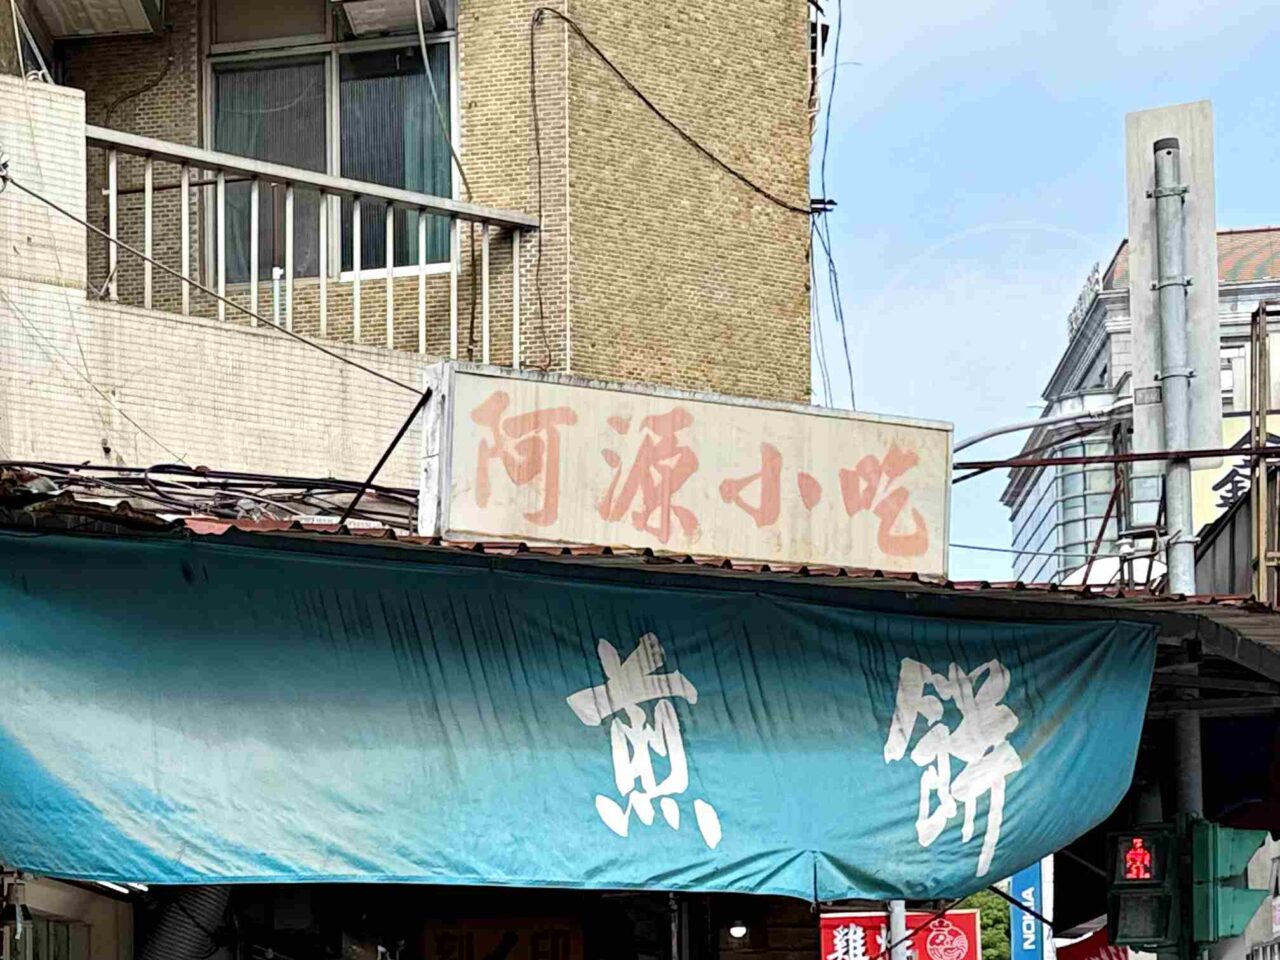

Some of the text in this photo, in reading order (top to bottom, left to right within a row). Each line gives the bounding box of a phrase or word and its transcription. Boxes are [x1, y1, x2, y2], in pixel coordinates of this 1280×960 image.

[470, 389, 928, 557] 阿源小吃
[567, 632, 1023, 877] 煎餅
[1021, 886, 1036, 950] NOKIA
